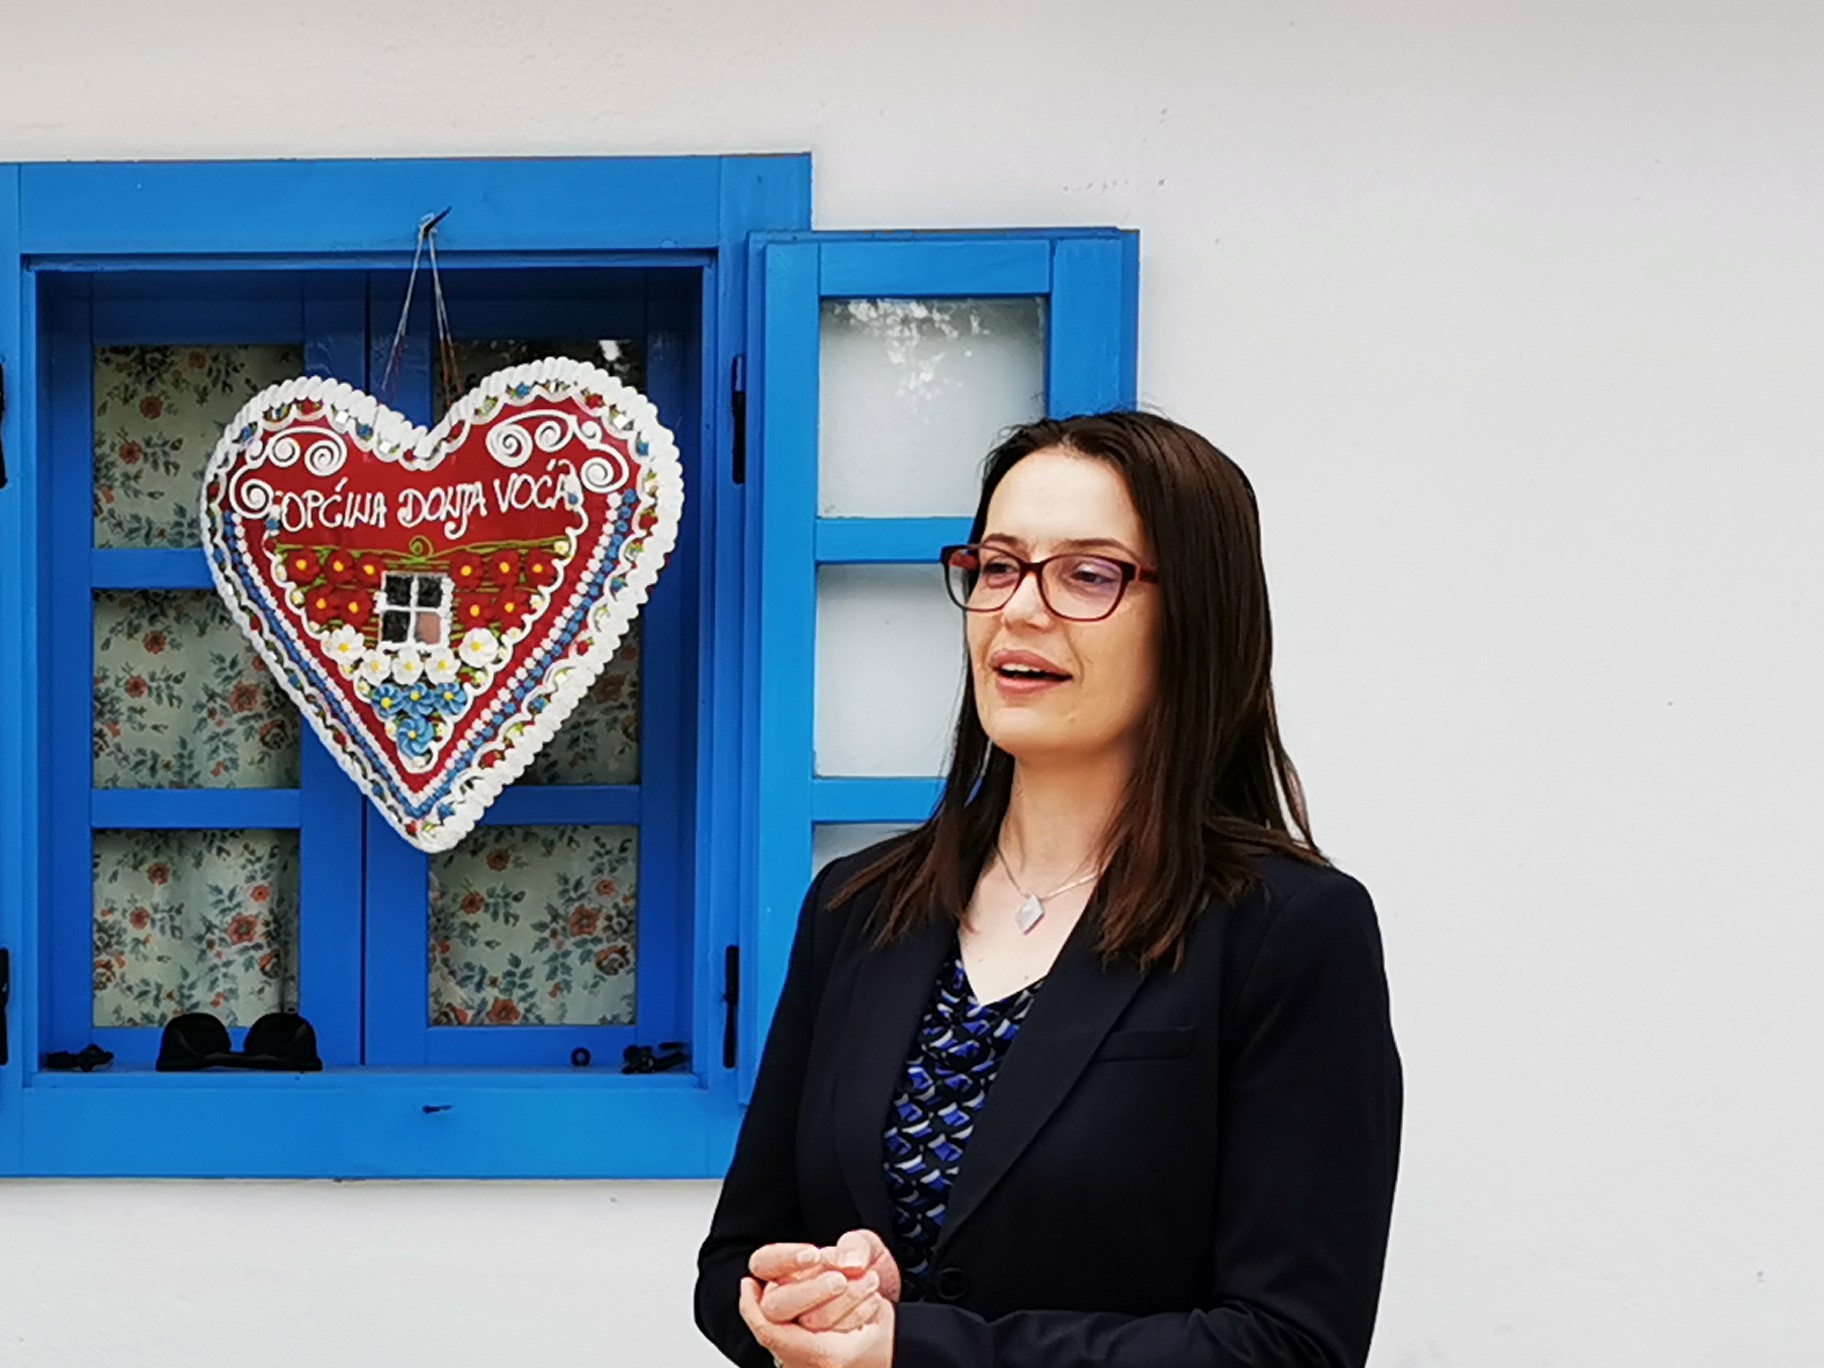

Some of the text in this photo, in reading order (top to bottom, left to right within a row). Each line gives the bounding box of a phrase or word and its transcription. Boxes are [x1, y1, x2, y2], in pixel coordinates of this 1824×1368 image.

[281, 458, 572, 540] OPĆINA DONJA VOĆA
